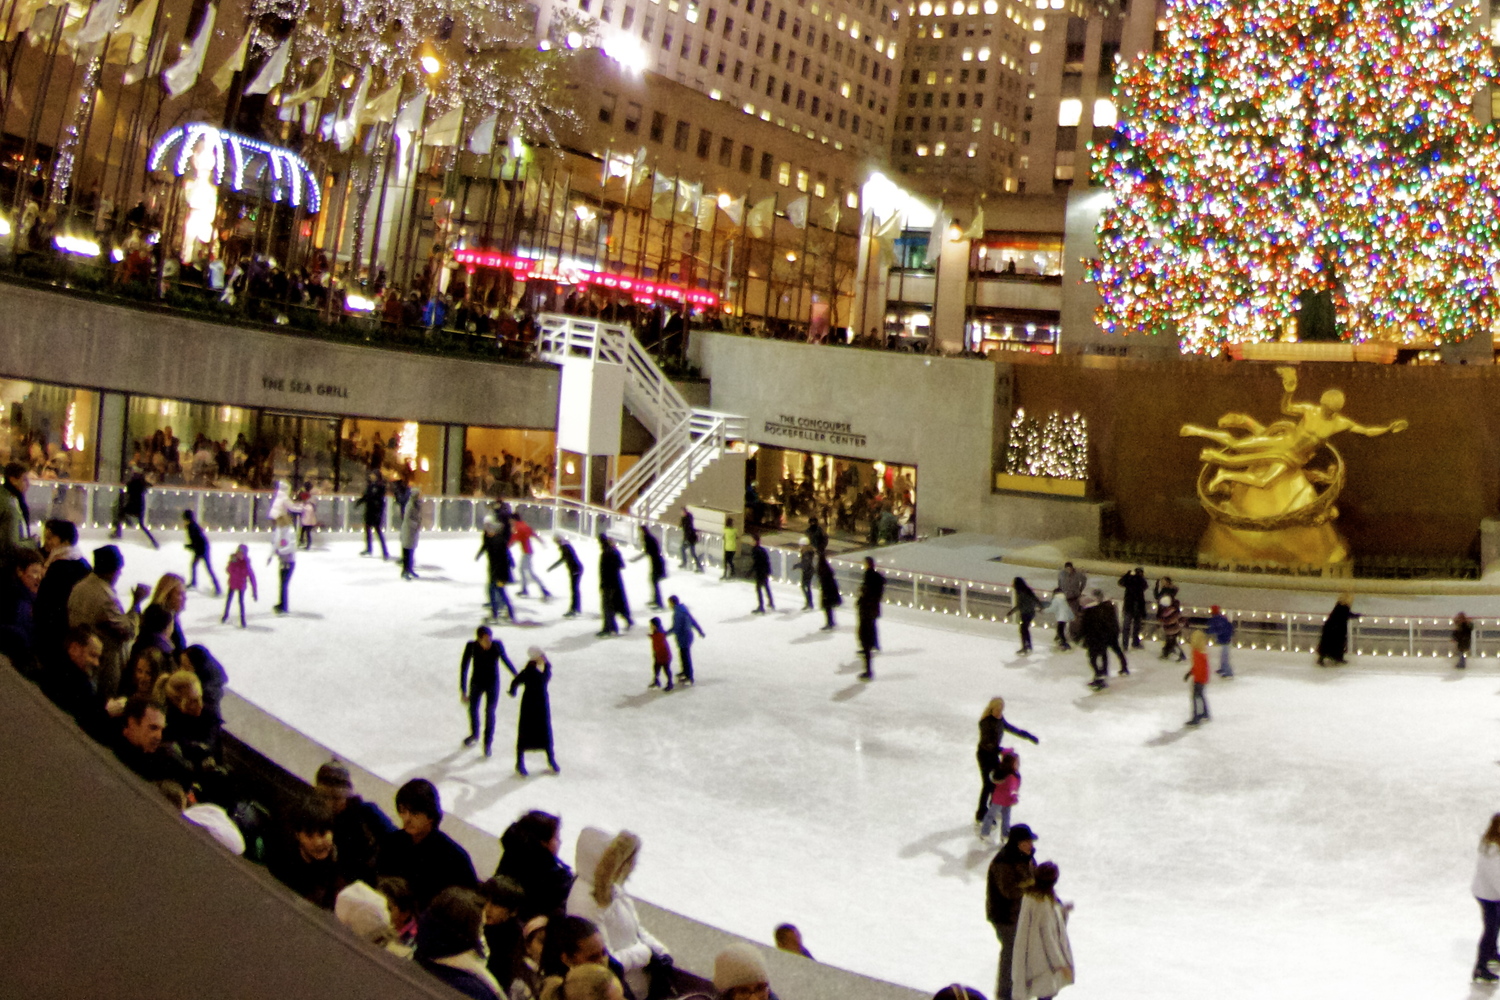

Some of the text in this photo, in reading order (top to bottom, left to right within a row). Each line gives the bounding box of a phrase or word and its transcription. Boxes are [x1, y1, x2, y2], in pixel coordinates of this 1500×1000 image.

[262, 376, 348, 399] THE SEA GRILL
[780, 415, 852, 433] THE CONCOURSE
[764, 424, 867, 448] ROCKEFELLER CENTER
